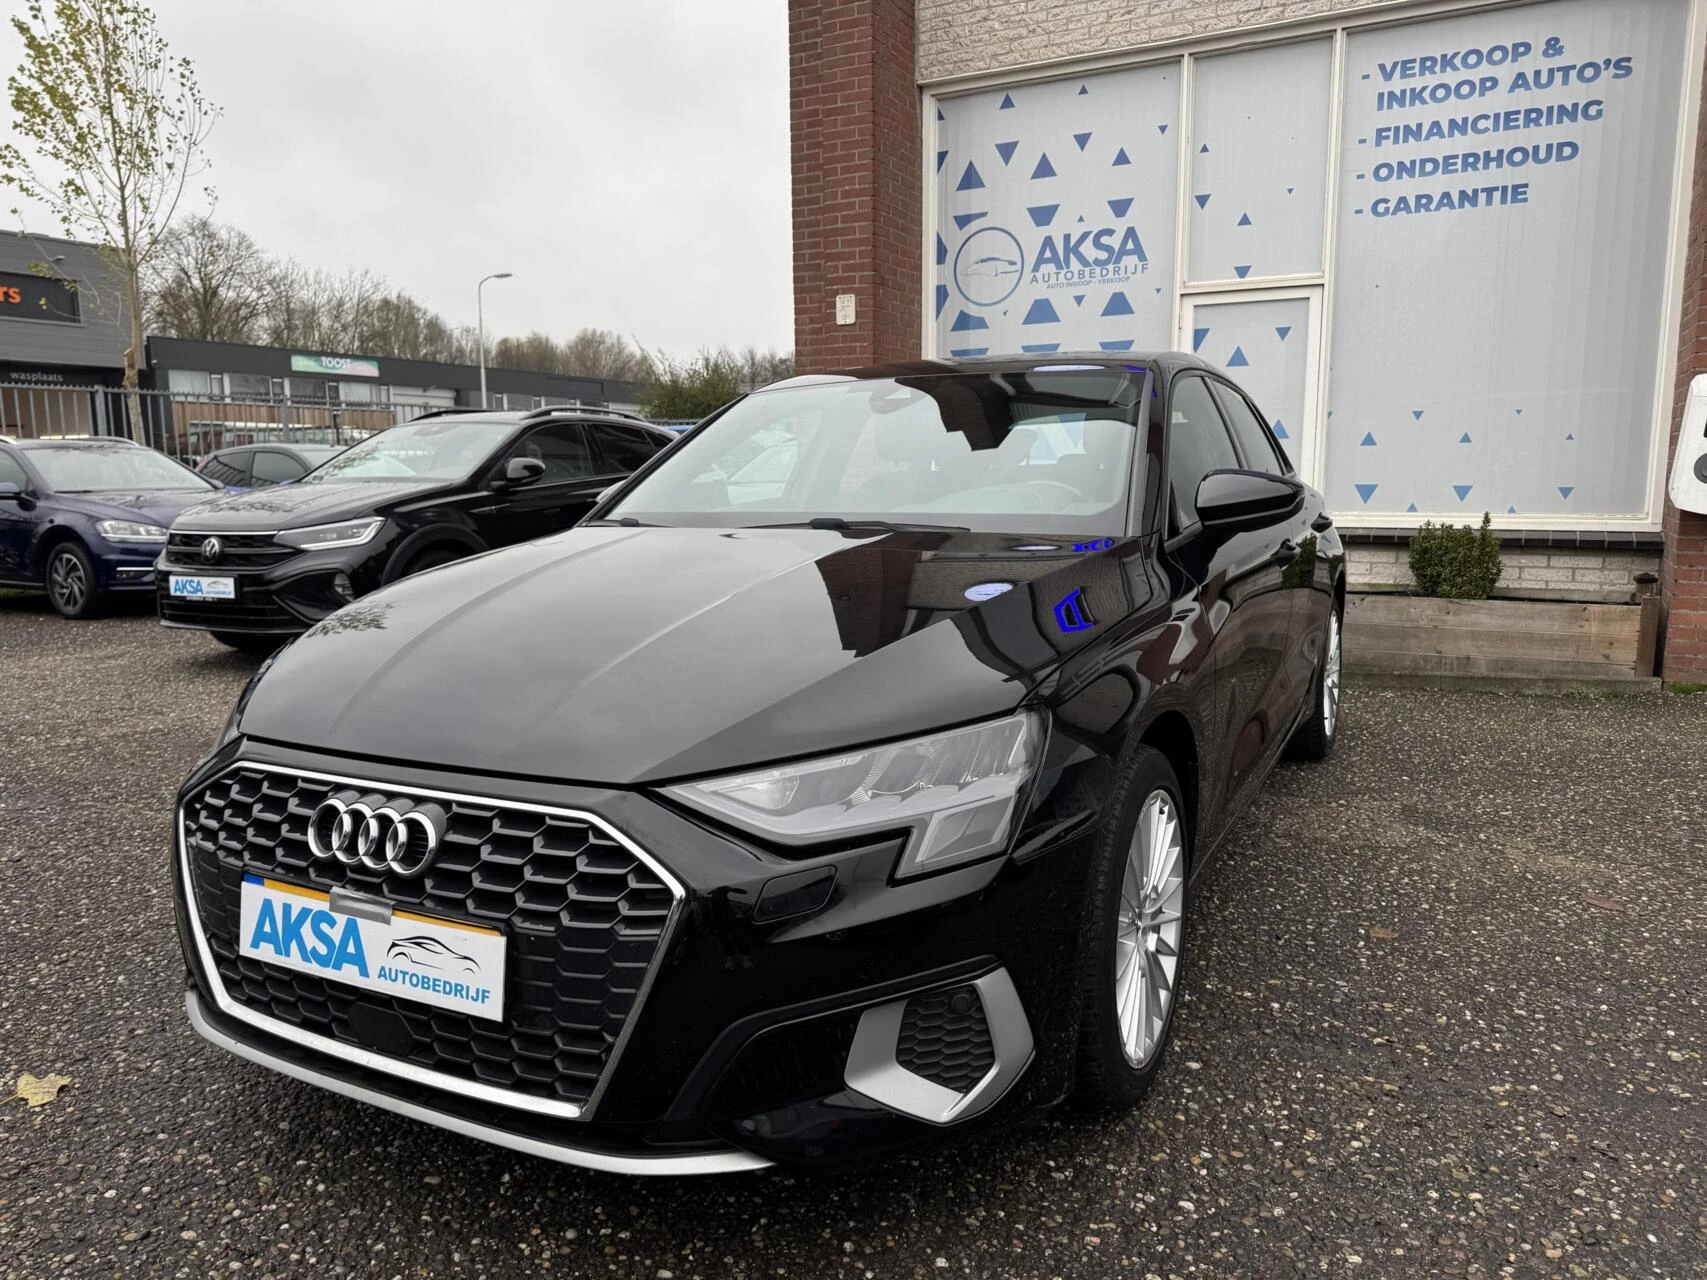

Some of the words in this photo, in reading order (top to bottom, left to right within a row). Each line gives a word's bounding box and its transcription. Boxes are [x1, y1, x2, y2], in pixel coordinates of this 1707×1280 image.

[1377, 41, 1532, 82] VERKOOP
[1541, 36, 1566, 59] &
[1376, 76, 1499, 112] INKOOP
[1507, 56, 1633, 94] AUTO'S
[1374, 99, 1605, 148] FINANCIERING
[1372, 140, 1580, 183] ONDERHOUD
[1370, 182, 1529, 218] GARANTIE
[1031, 226, 1149, 274] AKSA
[1030, 262, 1149, 285] AUTOBEDRIJF
[1046, 281, 1065, 290] AUTO
[1097, 276, 1131, 285] VERKOOP
[10, 371, 64, 382] wasplaats
[173, 579, 204, 595] AKSA
[249, 897, 370, 979] AKSA
[377, 965, 491, 1004] AUTOBEDRIJF
